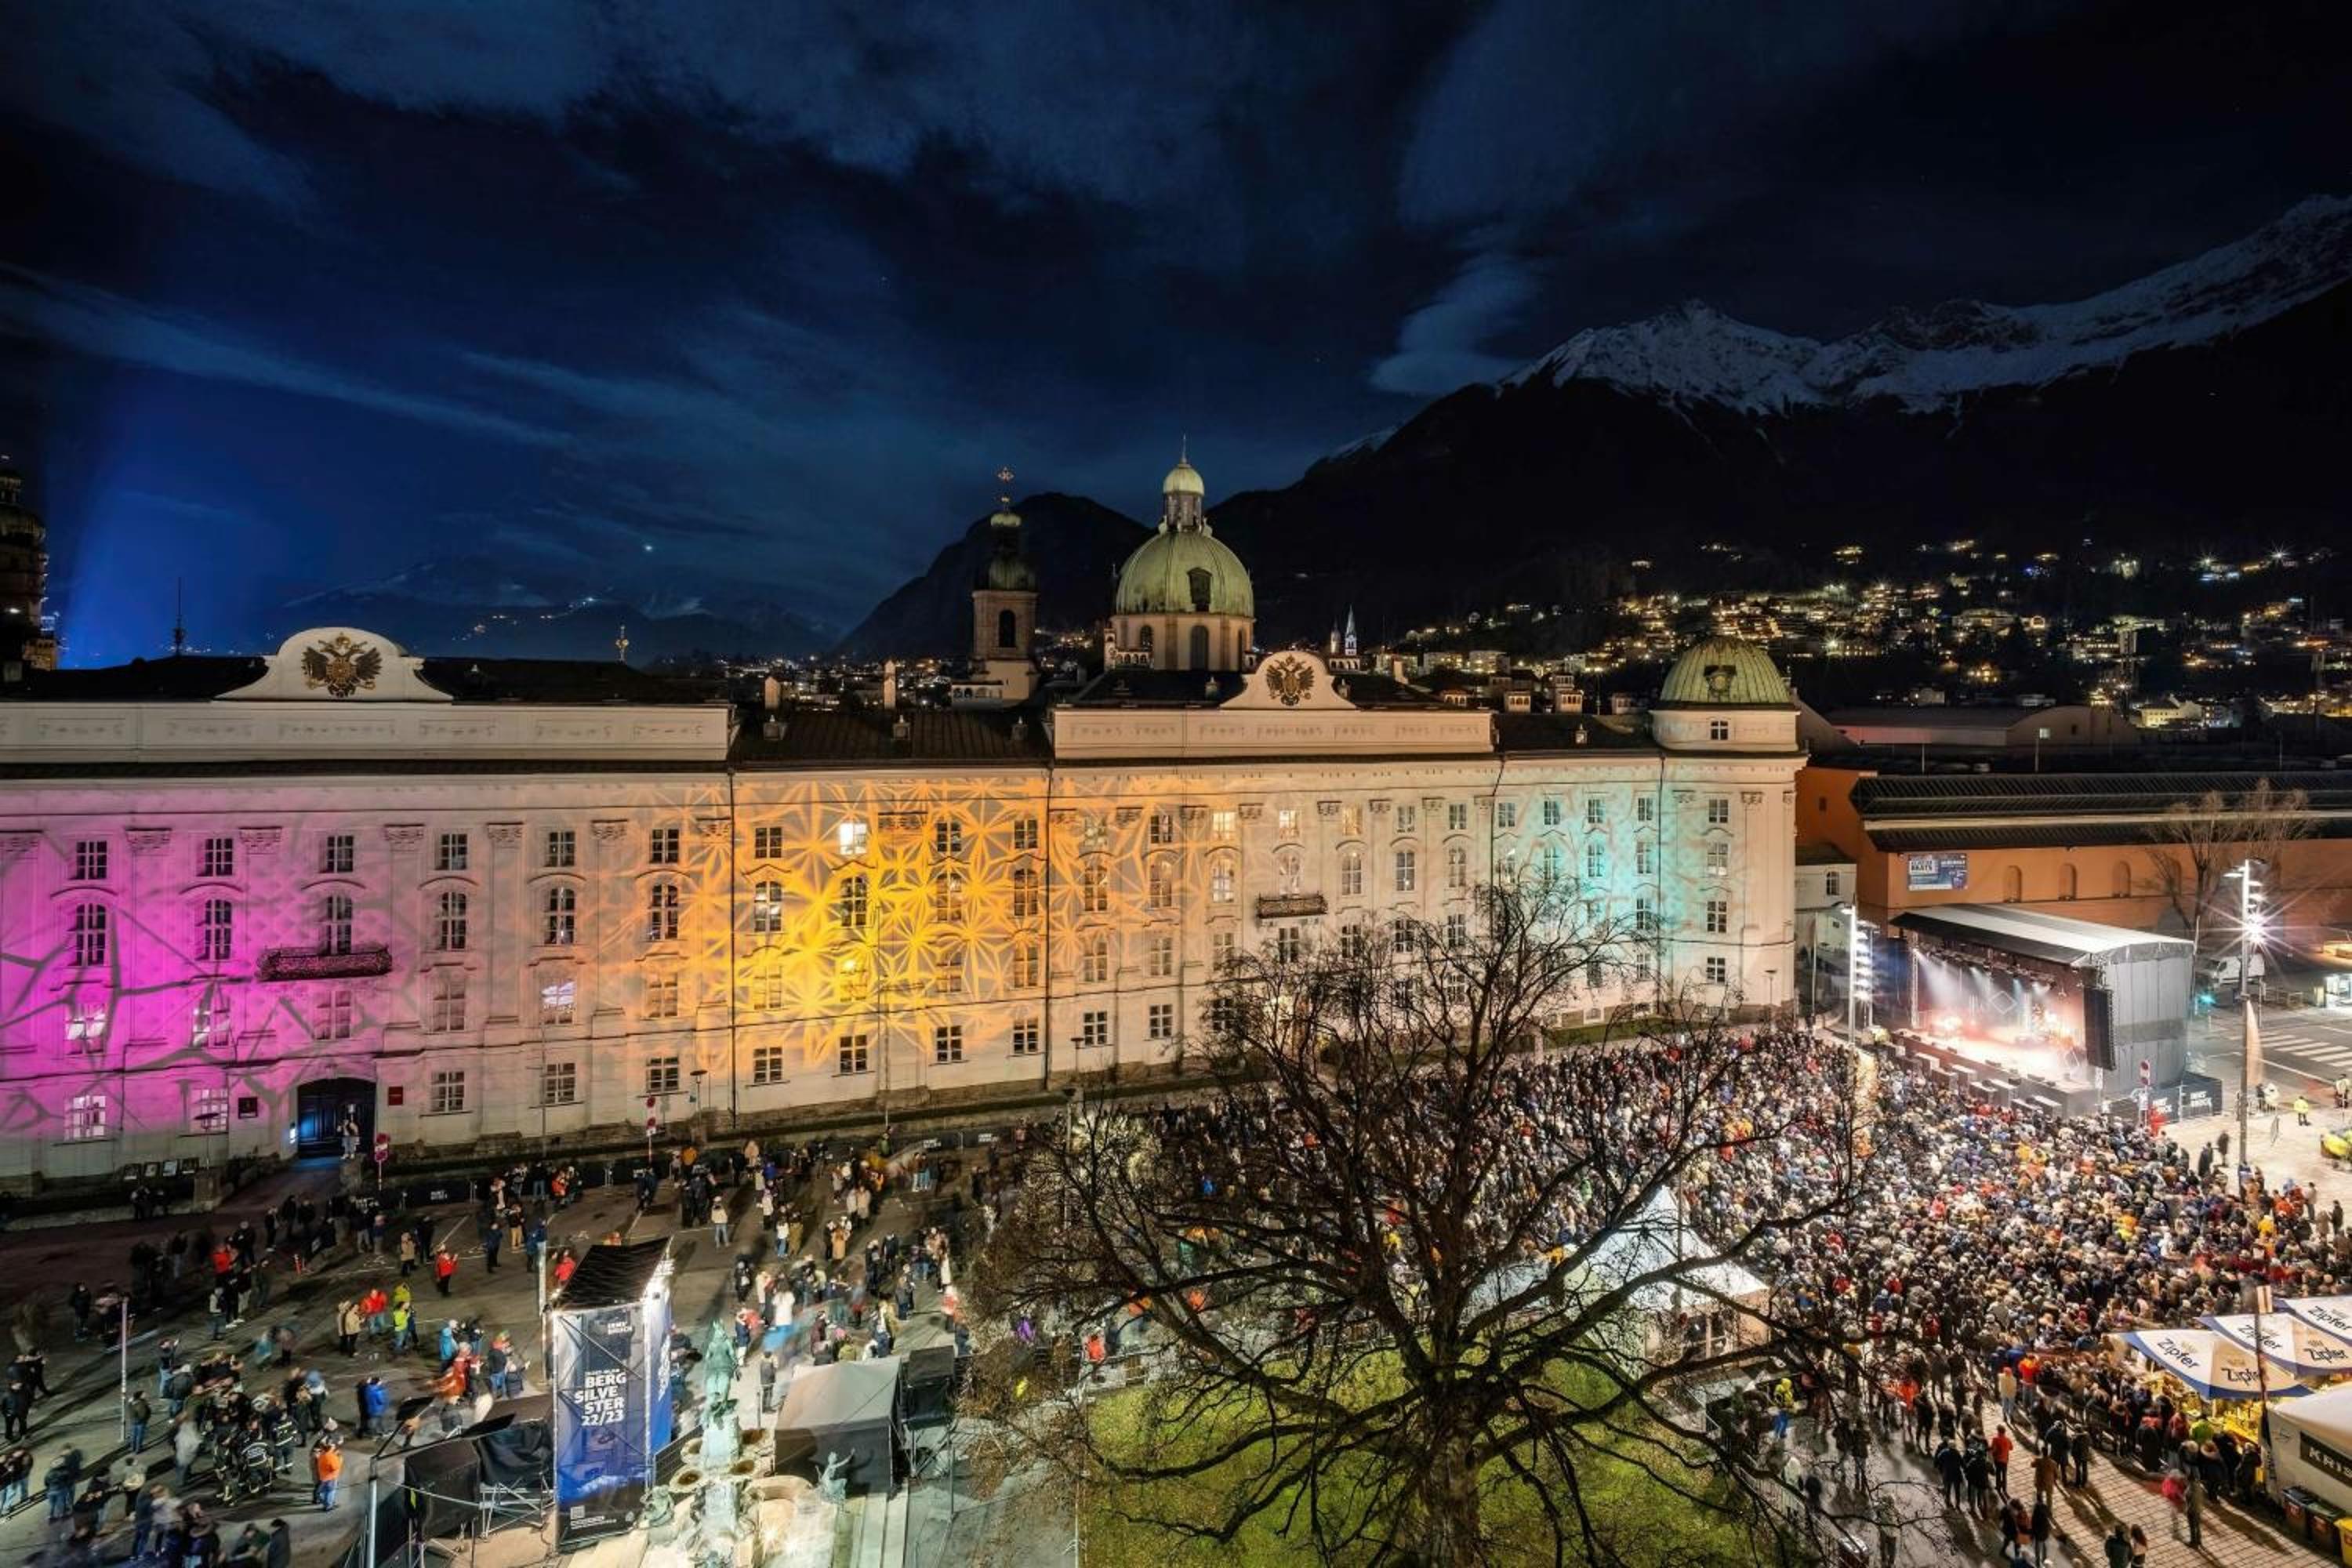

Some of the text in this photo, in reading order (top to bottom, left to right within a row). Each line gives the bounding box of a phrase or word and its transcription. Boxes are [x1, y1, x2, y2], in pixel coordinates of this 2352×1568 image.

[2308, 1305, 2352, 1330] Zipfer
[2157, 1338, 2200, 1367] Zipfer
[585, 1373, 626, 1388] BERG
[574, 1385, 618, 1404] SILVE
[584, 1396, 625, 1414] STER
[581, 1410, 624, 1426] 22/23
